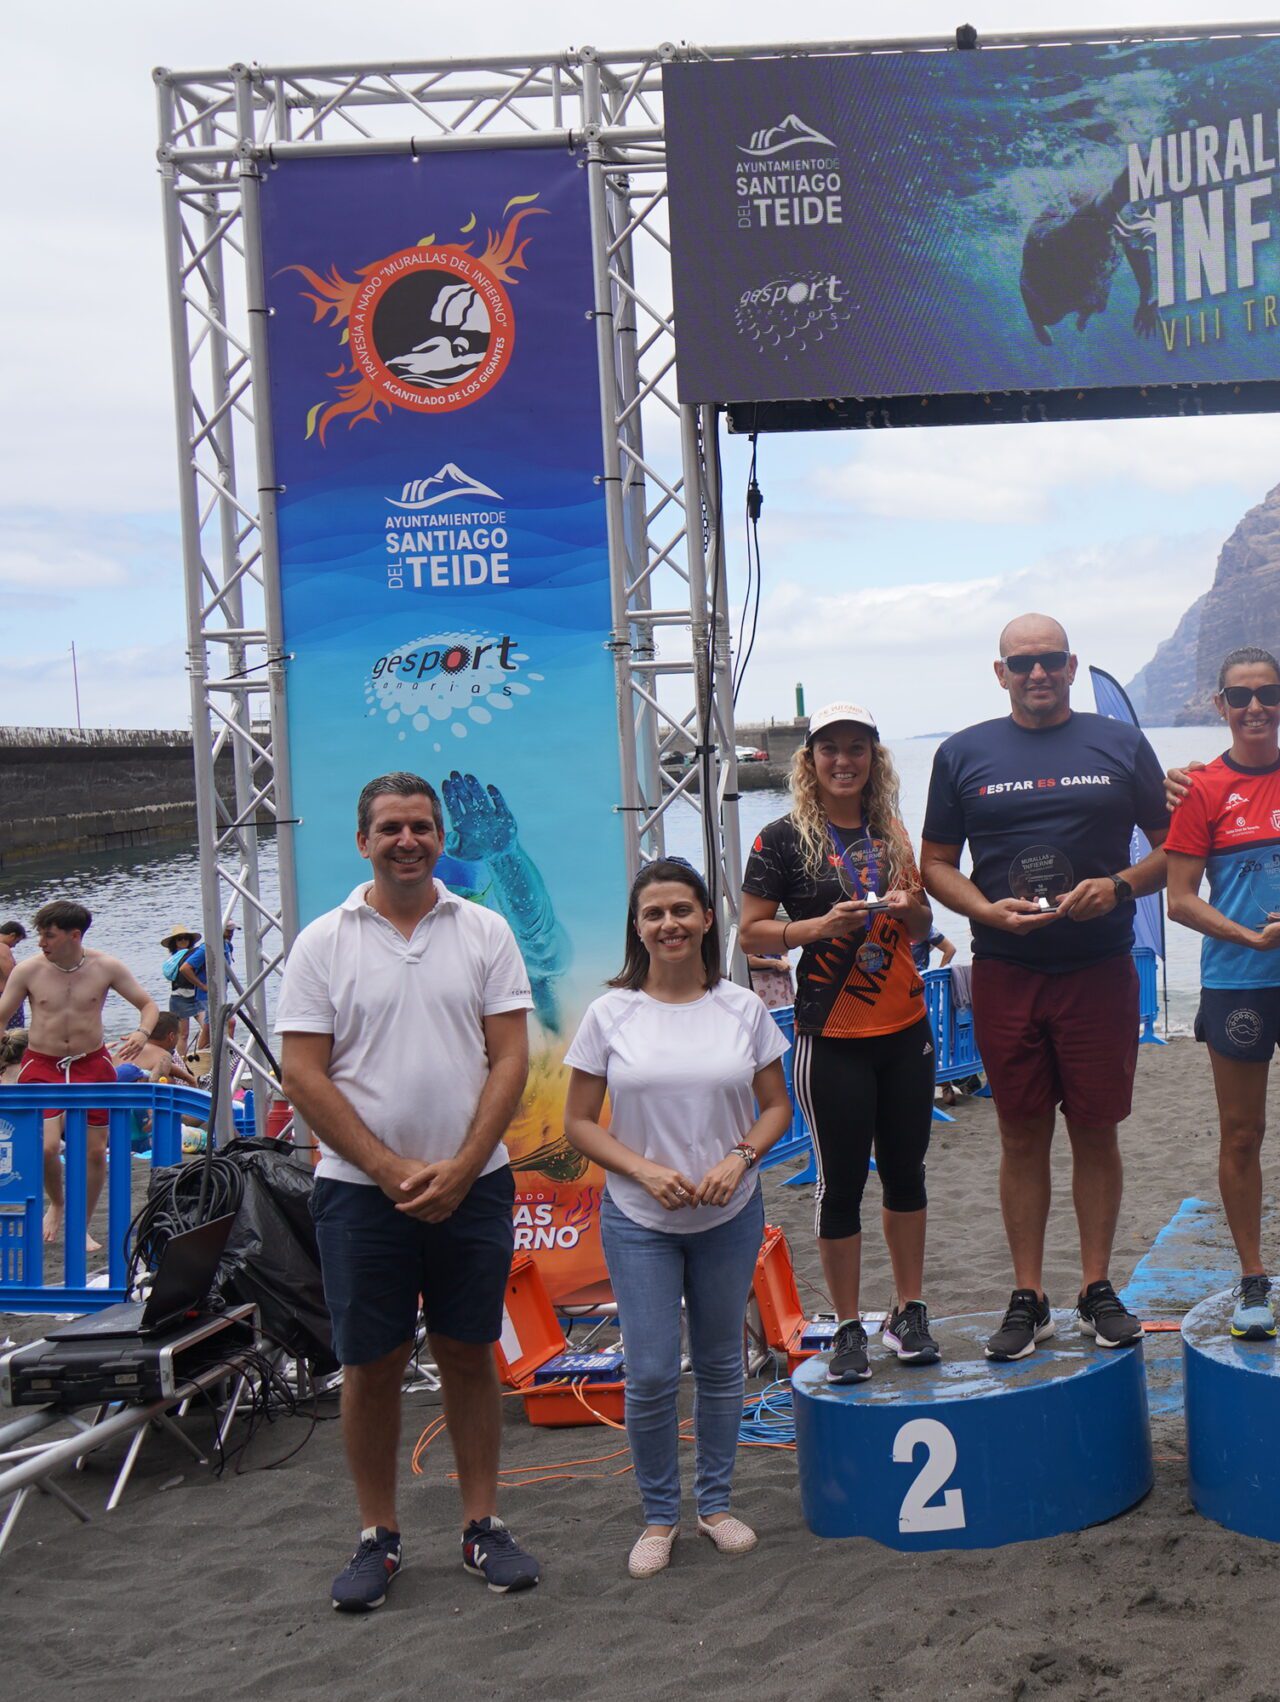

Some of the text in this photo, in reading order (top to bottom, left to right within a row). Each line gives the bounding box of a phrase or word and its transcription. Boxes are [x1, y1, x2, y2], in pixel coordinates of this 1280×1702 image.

[736, 173, 841, 196] SANTIAGO
[738, 200, 751, 228] DEL
[754, 196, 843, 227] TEIDE
[450, 256, 470, 275] DEL
[359, 276, 382, 311] NADO
[1162, 308, 1221, 351] VIII
[352, 322, 379, 380] TRAVESÍA
[383, 337, 505, 405] ACANTILADO DE LOS GIGANTES
[386, 527, 508, 554] SANTIAGO
[388, 557, 403, 589] DEL
[406, 553, 510, 587] TEIDE
[372, 636, 518, 680] gesport
[978, 775, 1111, 796] #ESTAR ES GANAR
[892, 1418, 966, 1533] 2
